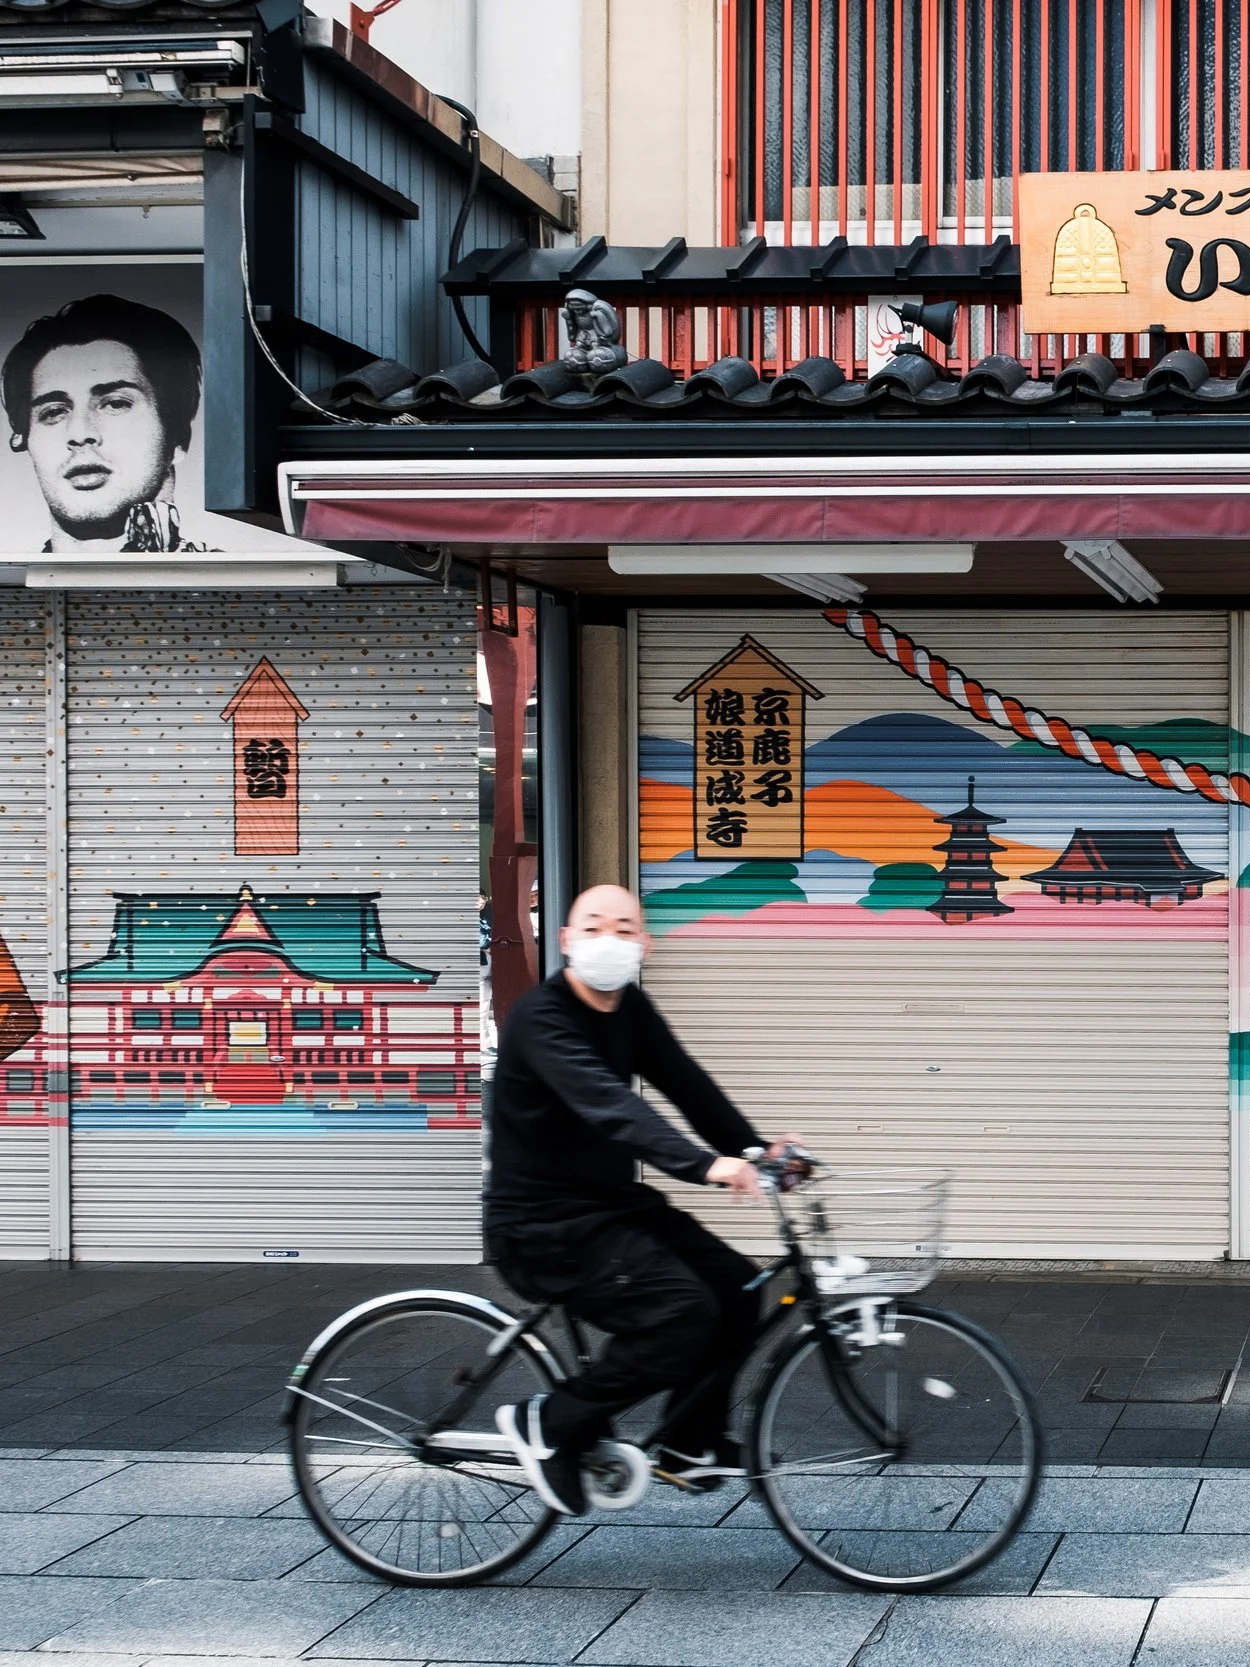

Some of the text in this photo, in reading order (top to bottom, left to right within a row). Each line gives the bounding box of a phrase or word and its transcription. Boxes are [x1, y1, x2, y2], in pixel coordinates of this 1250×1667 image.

[704, 687, 748, 849] 娘道成寺
[751, 687, 793, 808] 京鹿子
